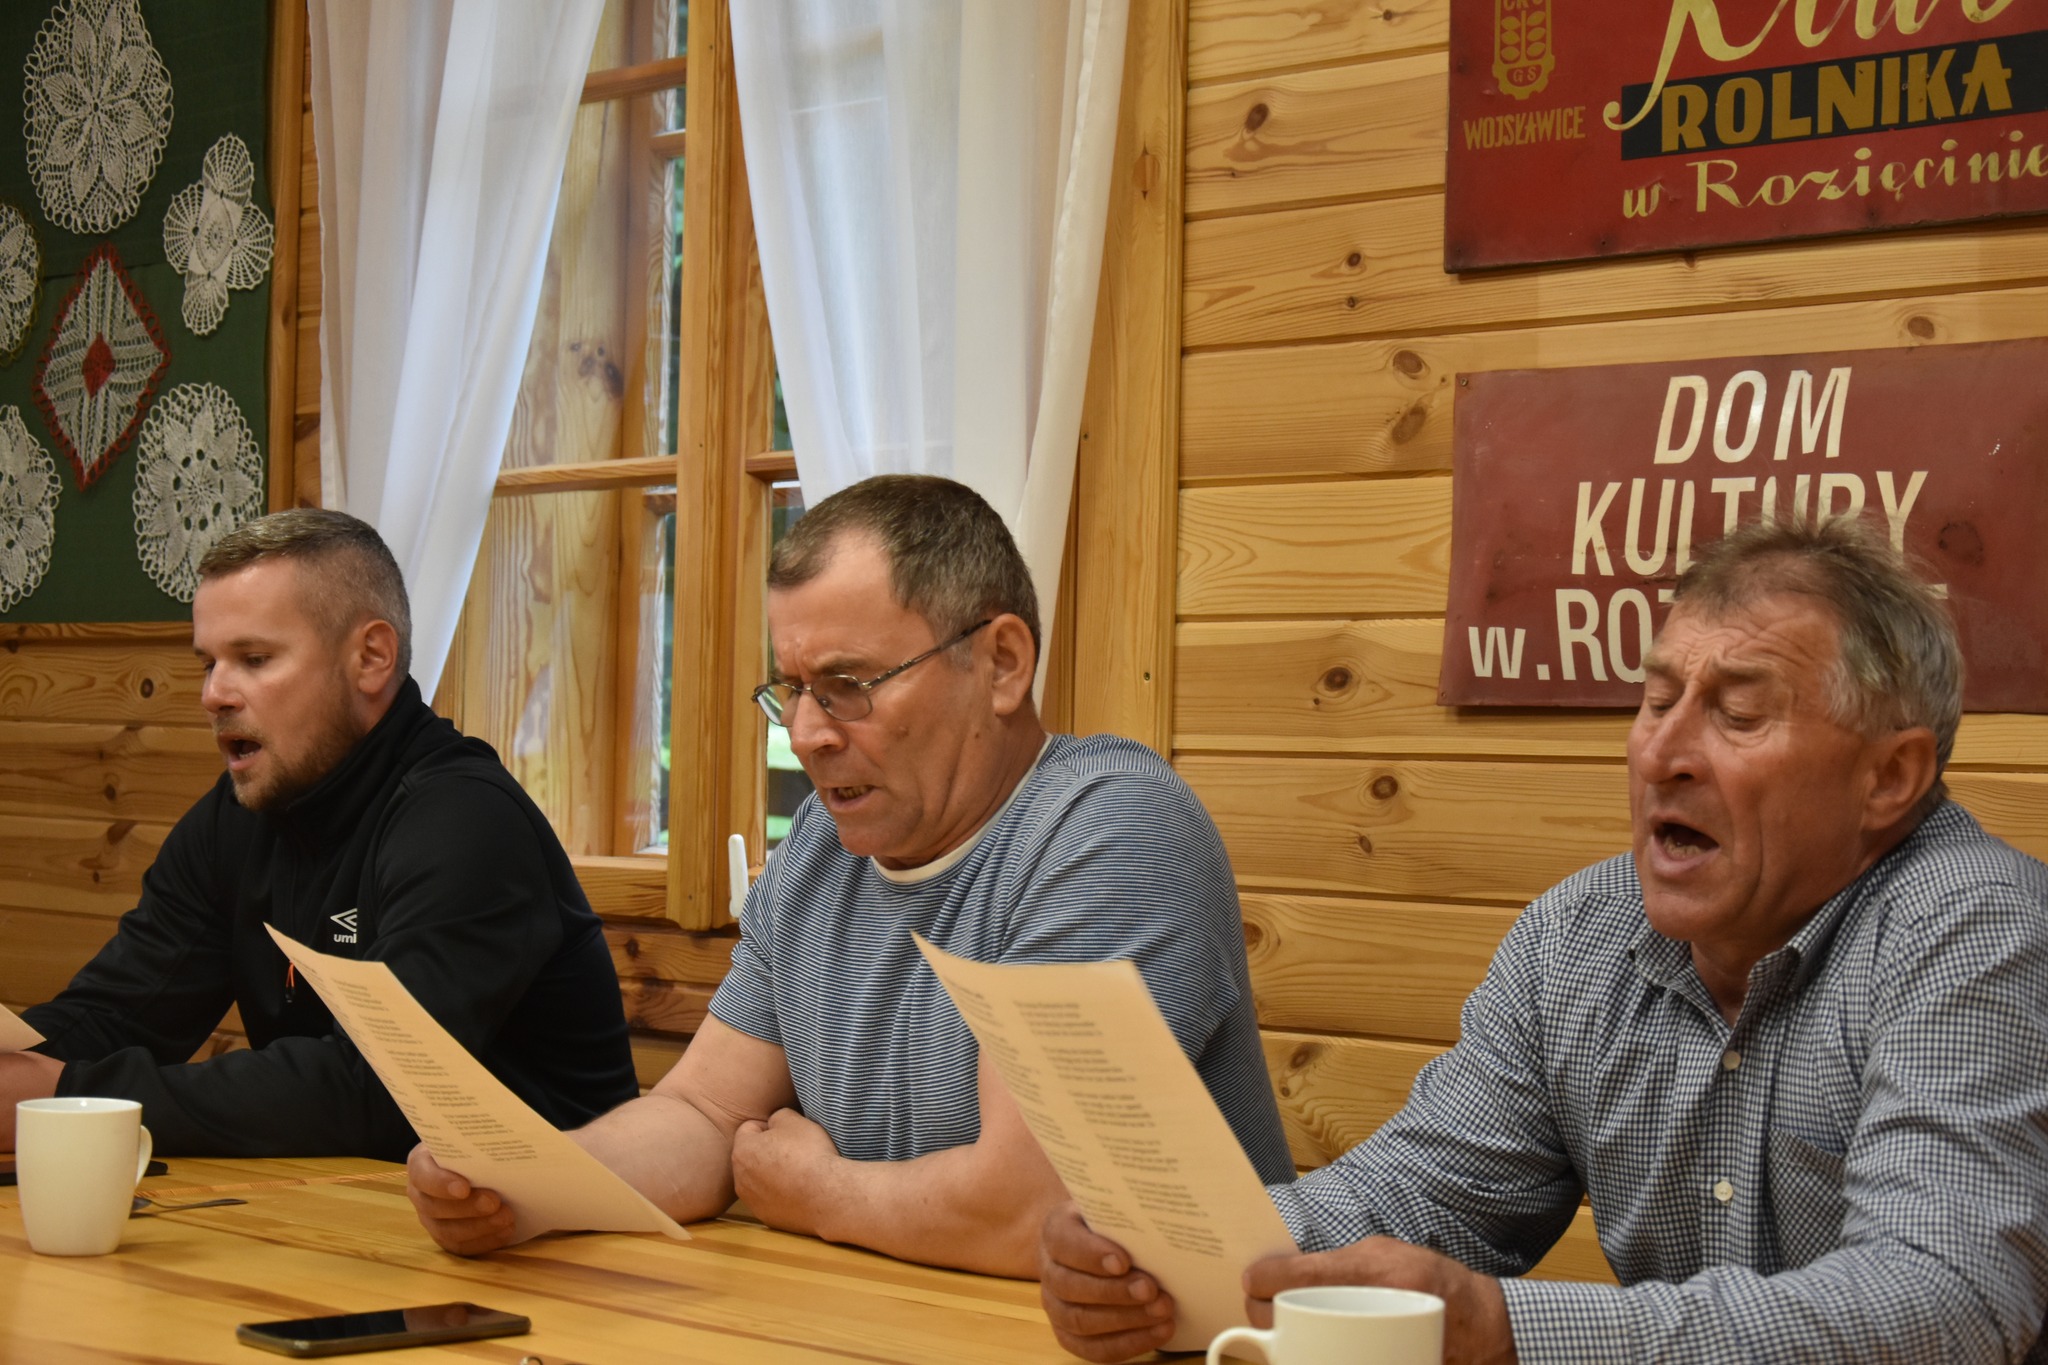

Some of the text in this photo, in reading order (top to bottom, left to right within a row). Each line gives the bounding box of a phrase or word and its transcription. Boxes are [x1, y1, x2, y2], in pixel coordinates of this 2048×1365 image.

[1463, 106, 1586, 151] WOJSŁAWICE
[1661, 43, 2013, 153] ROLNIKA
[1622, 179, 1664, 219] w
[1653, 367, 1853, 465] DOM
